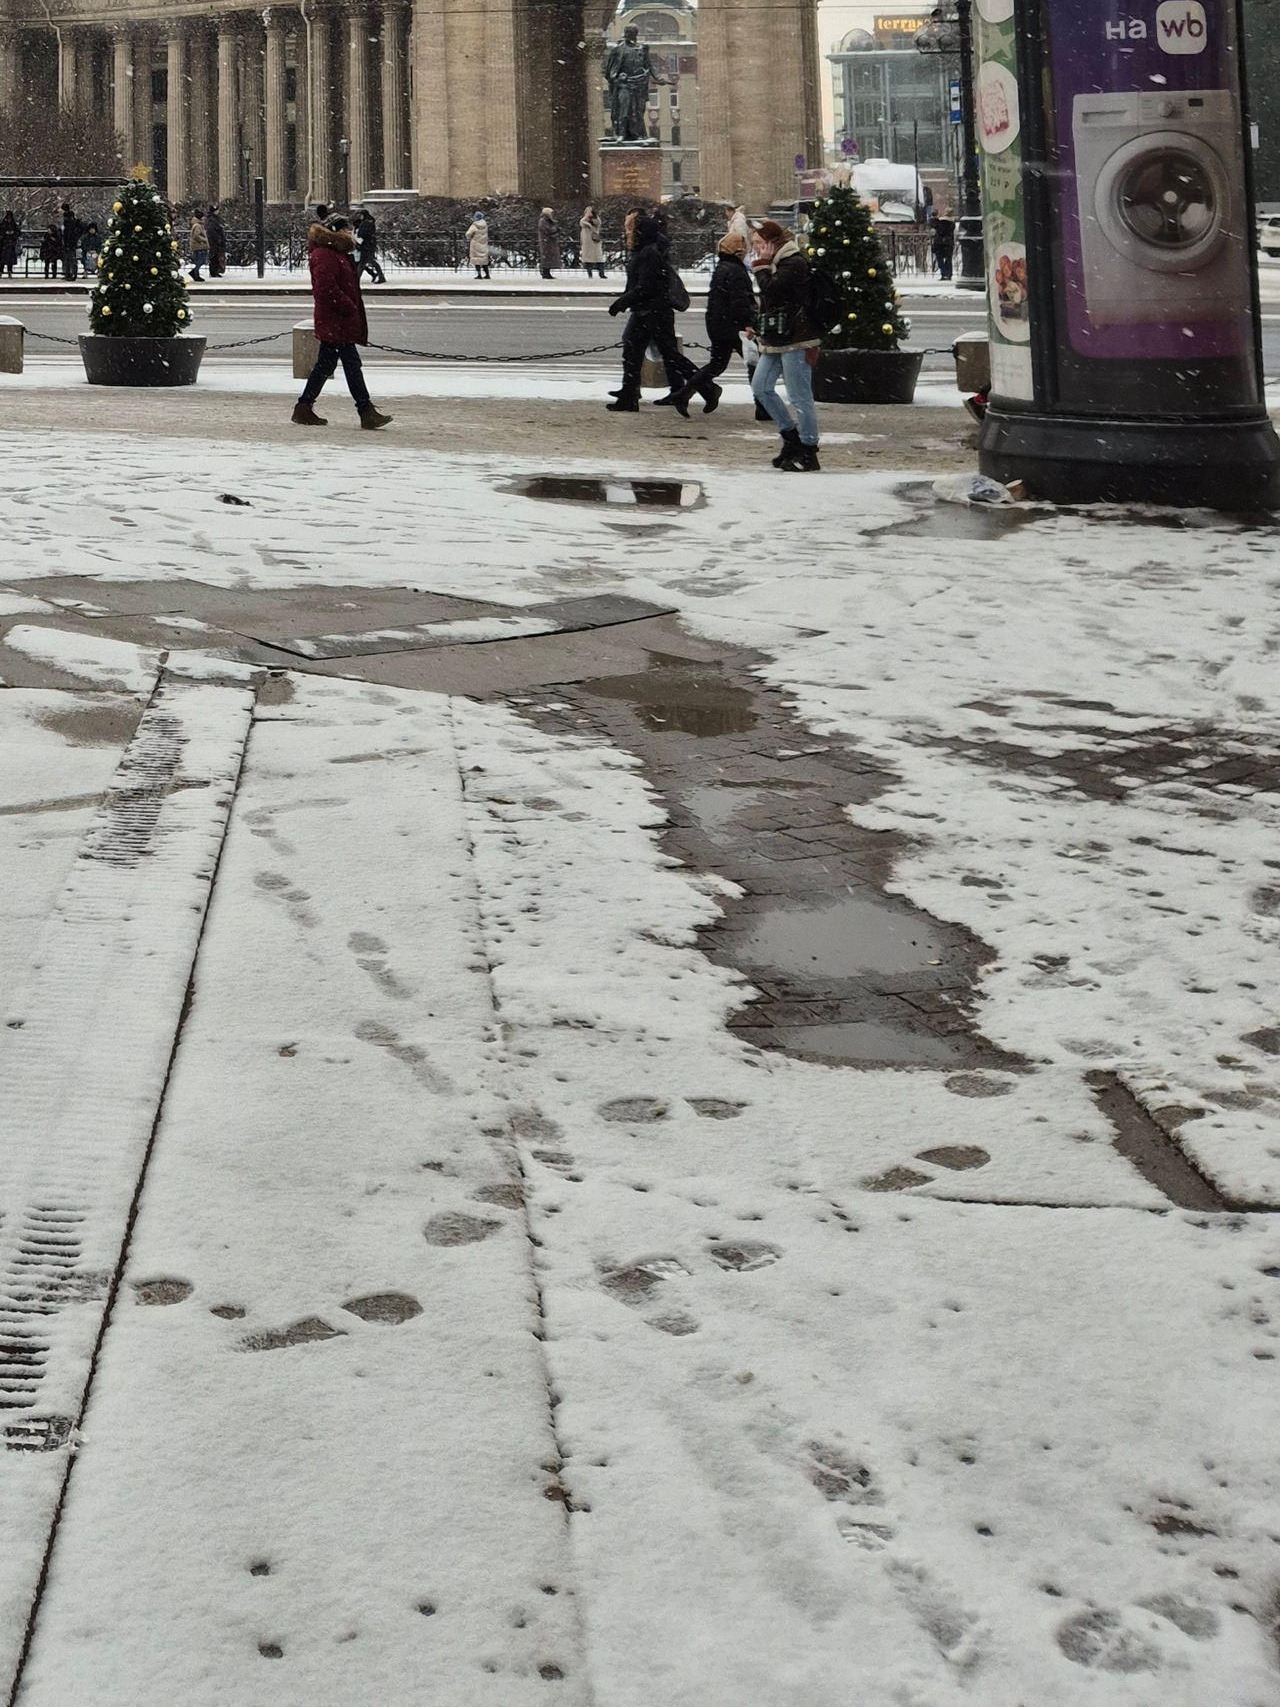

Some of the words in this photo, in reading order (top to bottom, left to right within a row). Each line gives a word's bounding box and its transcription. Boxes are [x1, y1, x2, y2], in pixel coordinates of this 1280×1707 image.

[877, 17, 932, 30] terras
[1105, 19, 1147, 40] на
[1160, 11, 1204, 38] wb
